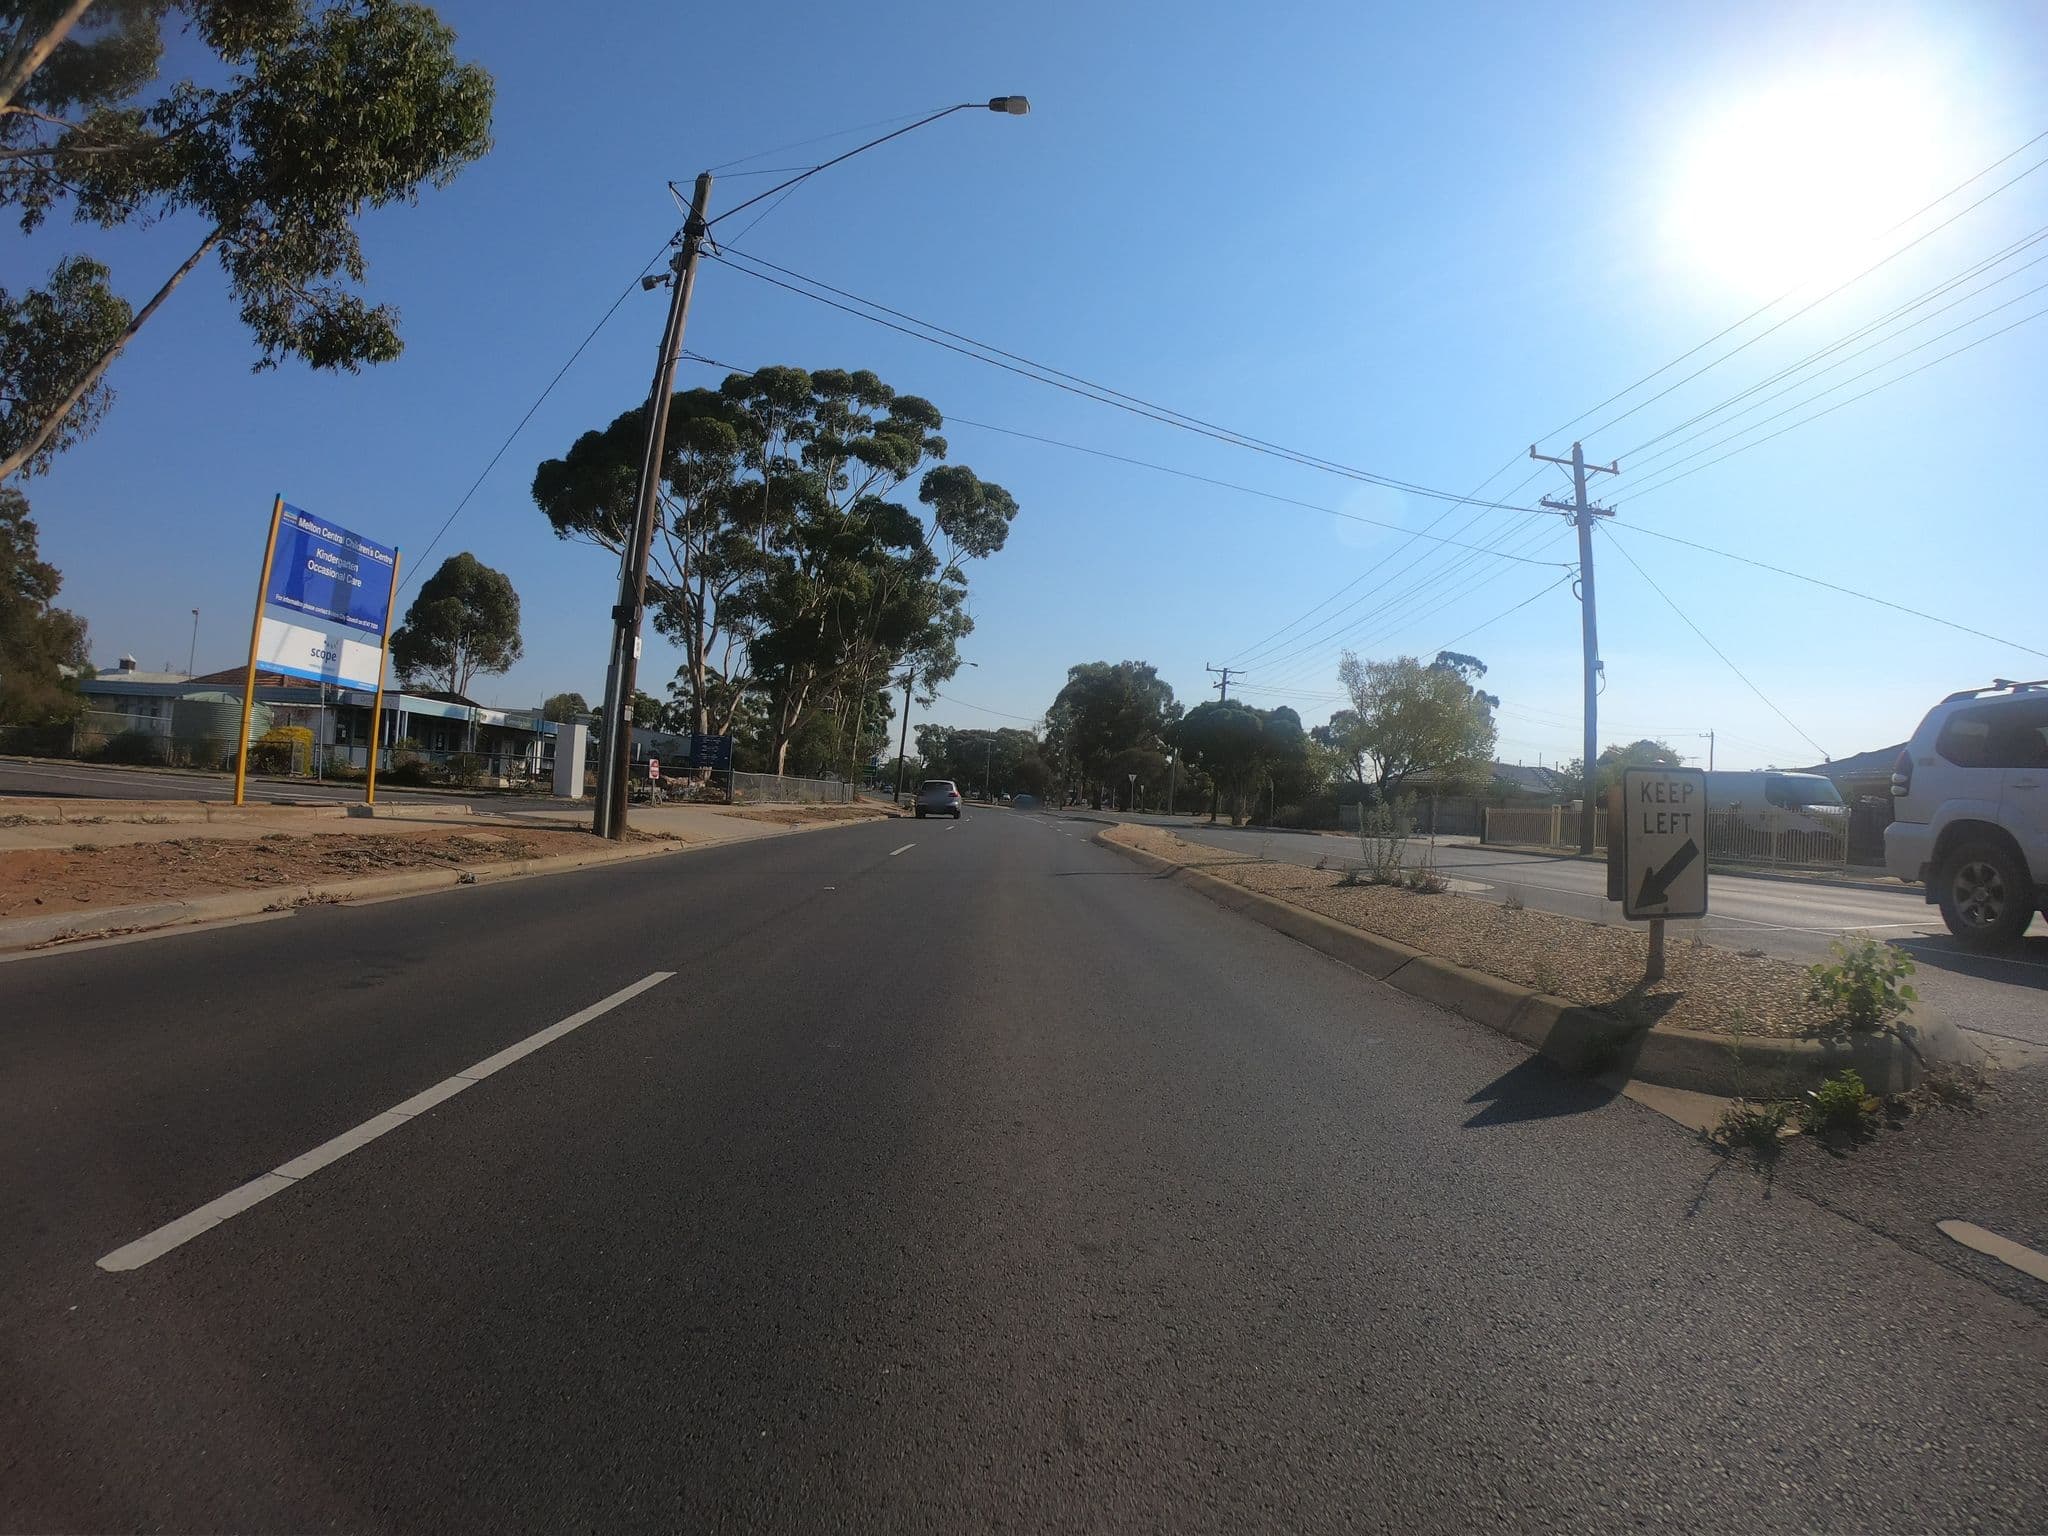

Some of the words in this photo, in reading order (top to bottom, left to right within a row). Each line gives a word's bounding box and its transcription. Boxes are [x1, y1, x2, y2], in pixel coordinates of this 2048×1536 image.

[298, 517, 321, 534] Melton
[322, 527, 345, 544] Central
[374, 550, 393, 565] Centre
[316, 548, 358, 572] Kindergarten
[308, 560, 345, 581] Occasional
[346, 574, 362, 587] Care
[311, 648, 337, 663] scope
[1641, 781, 1694, 804] KEEP
[1643, 813, 1691, 834] LEFT
